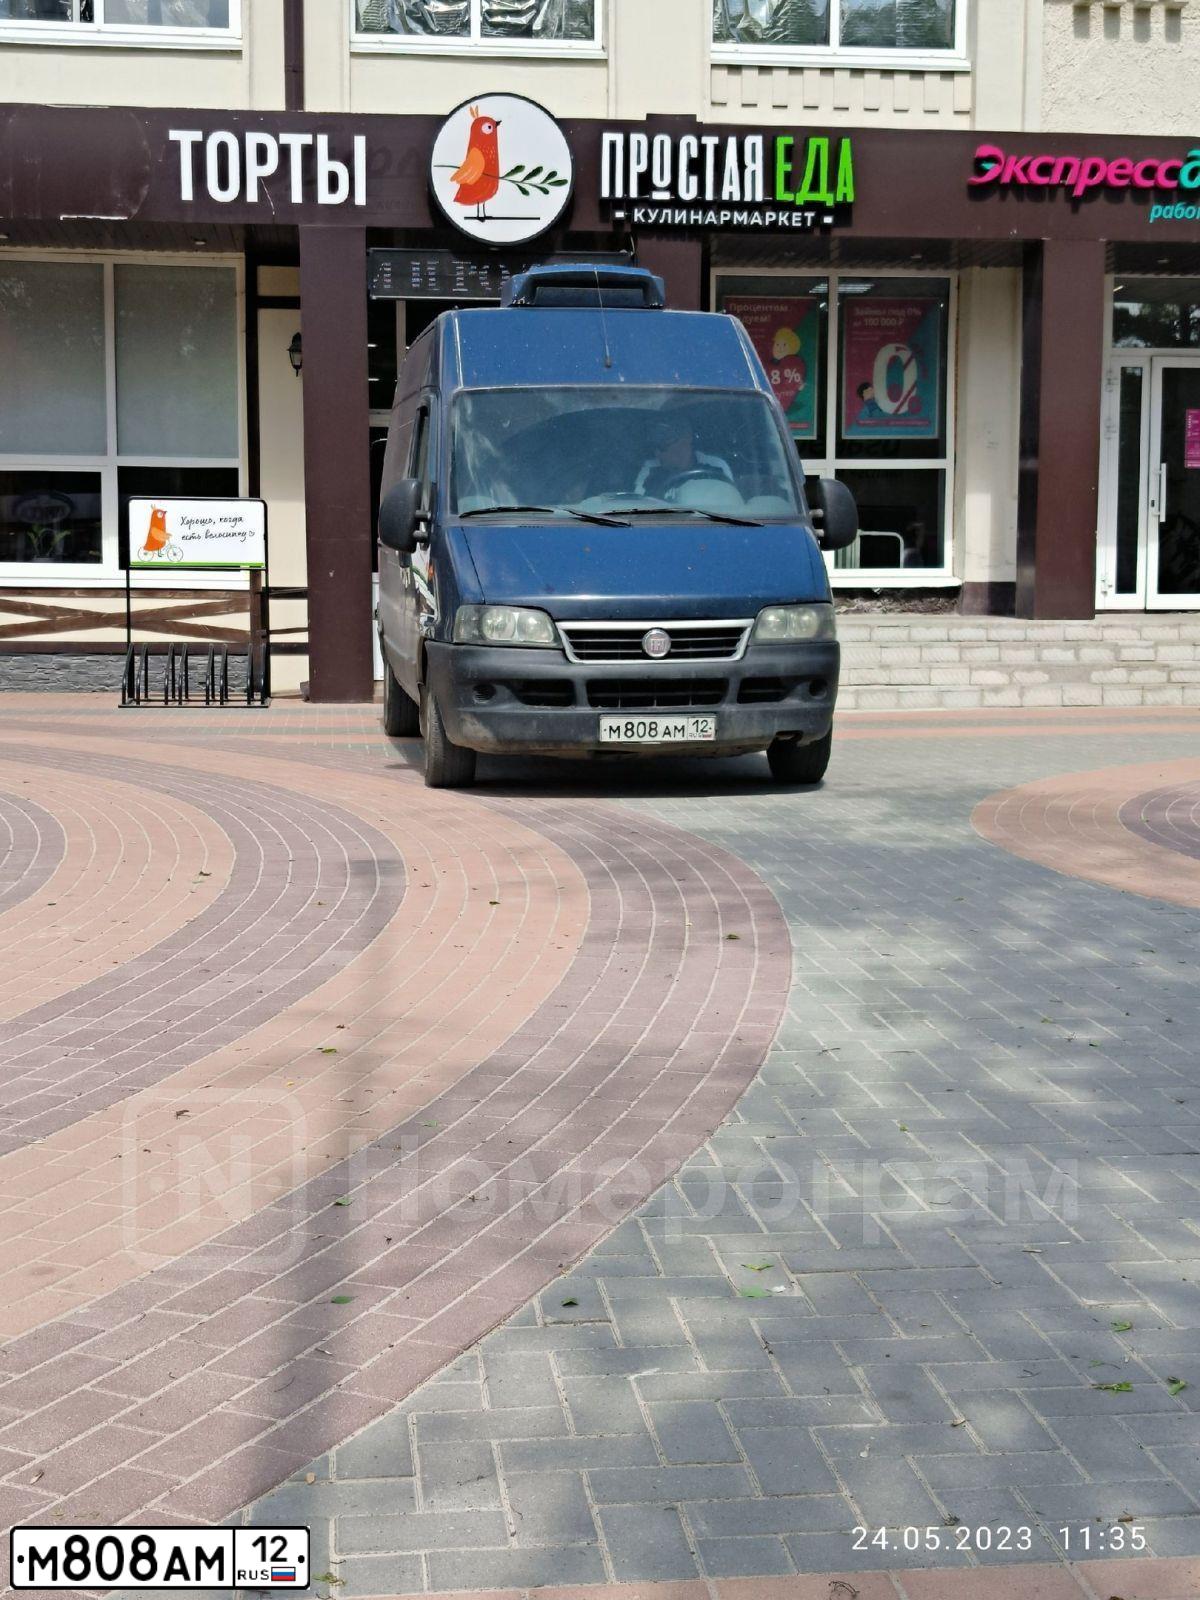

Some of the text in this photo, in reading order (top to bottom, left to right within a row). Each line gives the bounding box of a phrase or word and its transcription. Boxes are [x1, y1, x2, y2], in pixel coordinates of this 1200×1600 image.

[168, 130, 366, 206] ТОРТЫ
[601, 131, 855, 208] ПРОСТАЯ ЕДА
[632, 207, 817, 227] КУЛИНАРМАРКЕТ
[1149, 202, 1200, 224] рабо
[219, 516, 243, 528] когда
[181, 532, 201, 541] есть
[691, 719, 709, 734] 12
